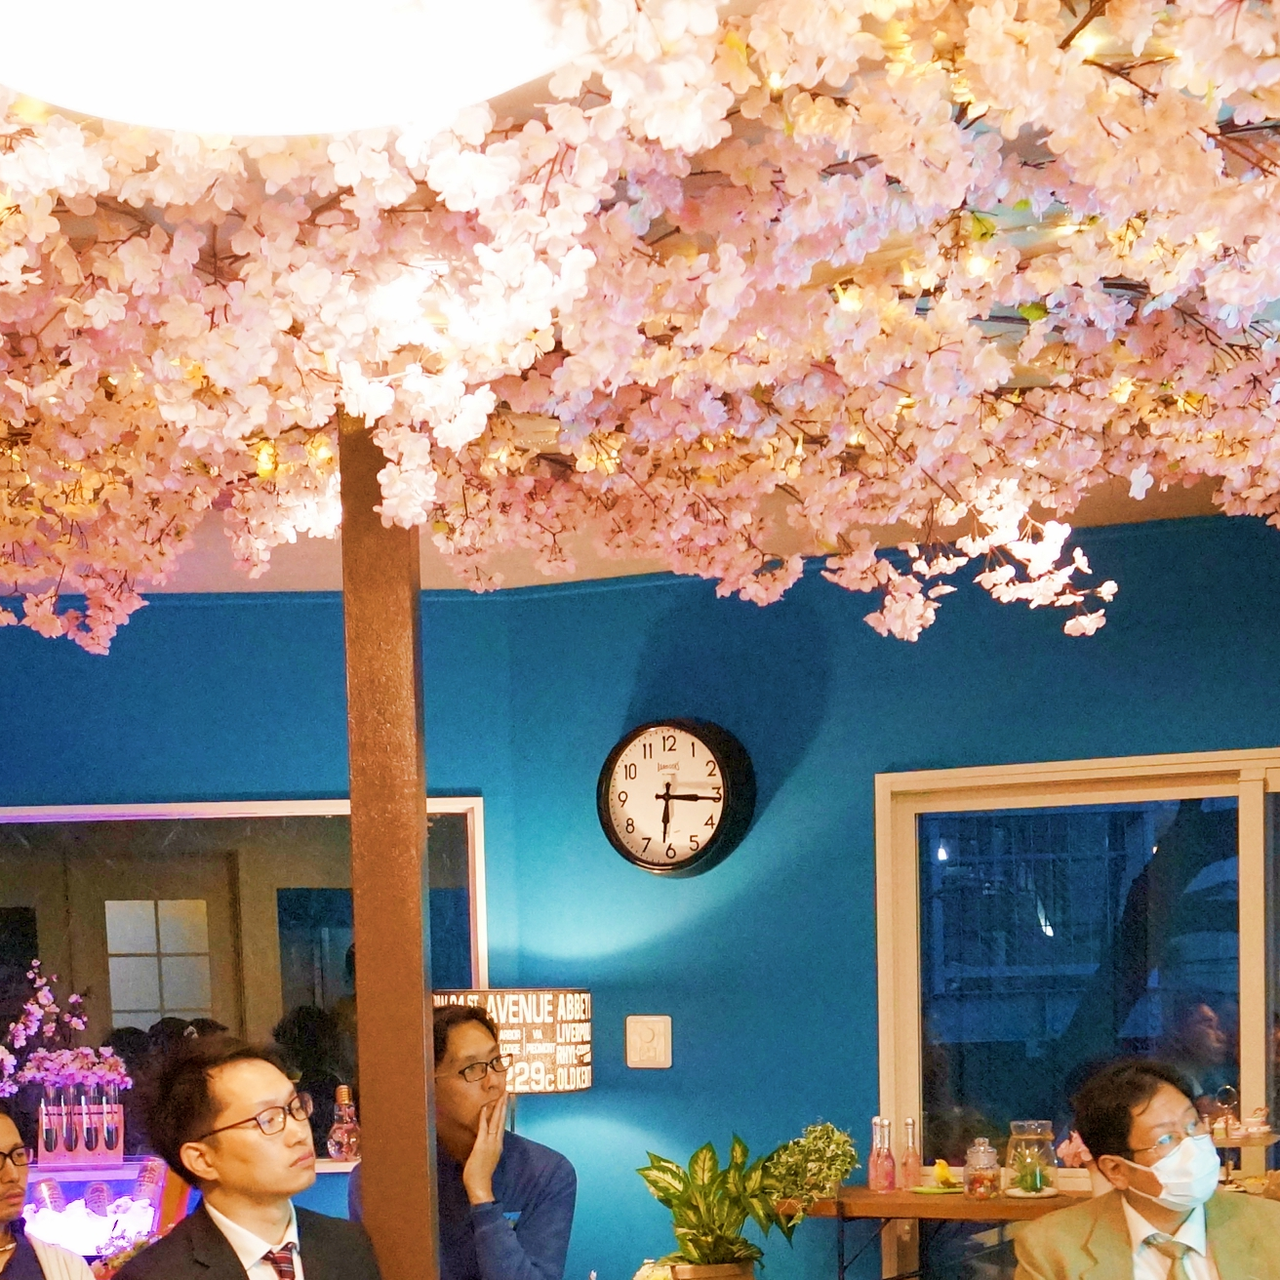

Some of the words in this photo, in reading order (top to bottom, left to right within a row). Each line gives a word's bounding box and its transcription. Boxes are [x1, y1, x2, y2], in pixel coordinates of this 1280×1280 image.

[643, 742, 652, 760] 11
[662, 735, 677, 752] 12
[691, 741, 695, 758] 1
[624, 763, 637, 780] 10
[705, 760, 717, 777] 2
[618, 791, 628, 808] 9
[711, 786, 722, 803] 3
[625, 817, 635, 834] 8
[704, 813, 716, 830] 4
[641, 837, 652, 853] 7
[665, 843, 676, 859] 6
[689, 835, 700, 852] 5
[487, 993, 554, 1023] AVENUE
